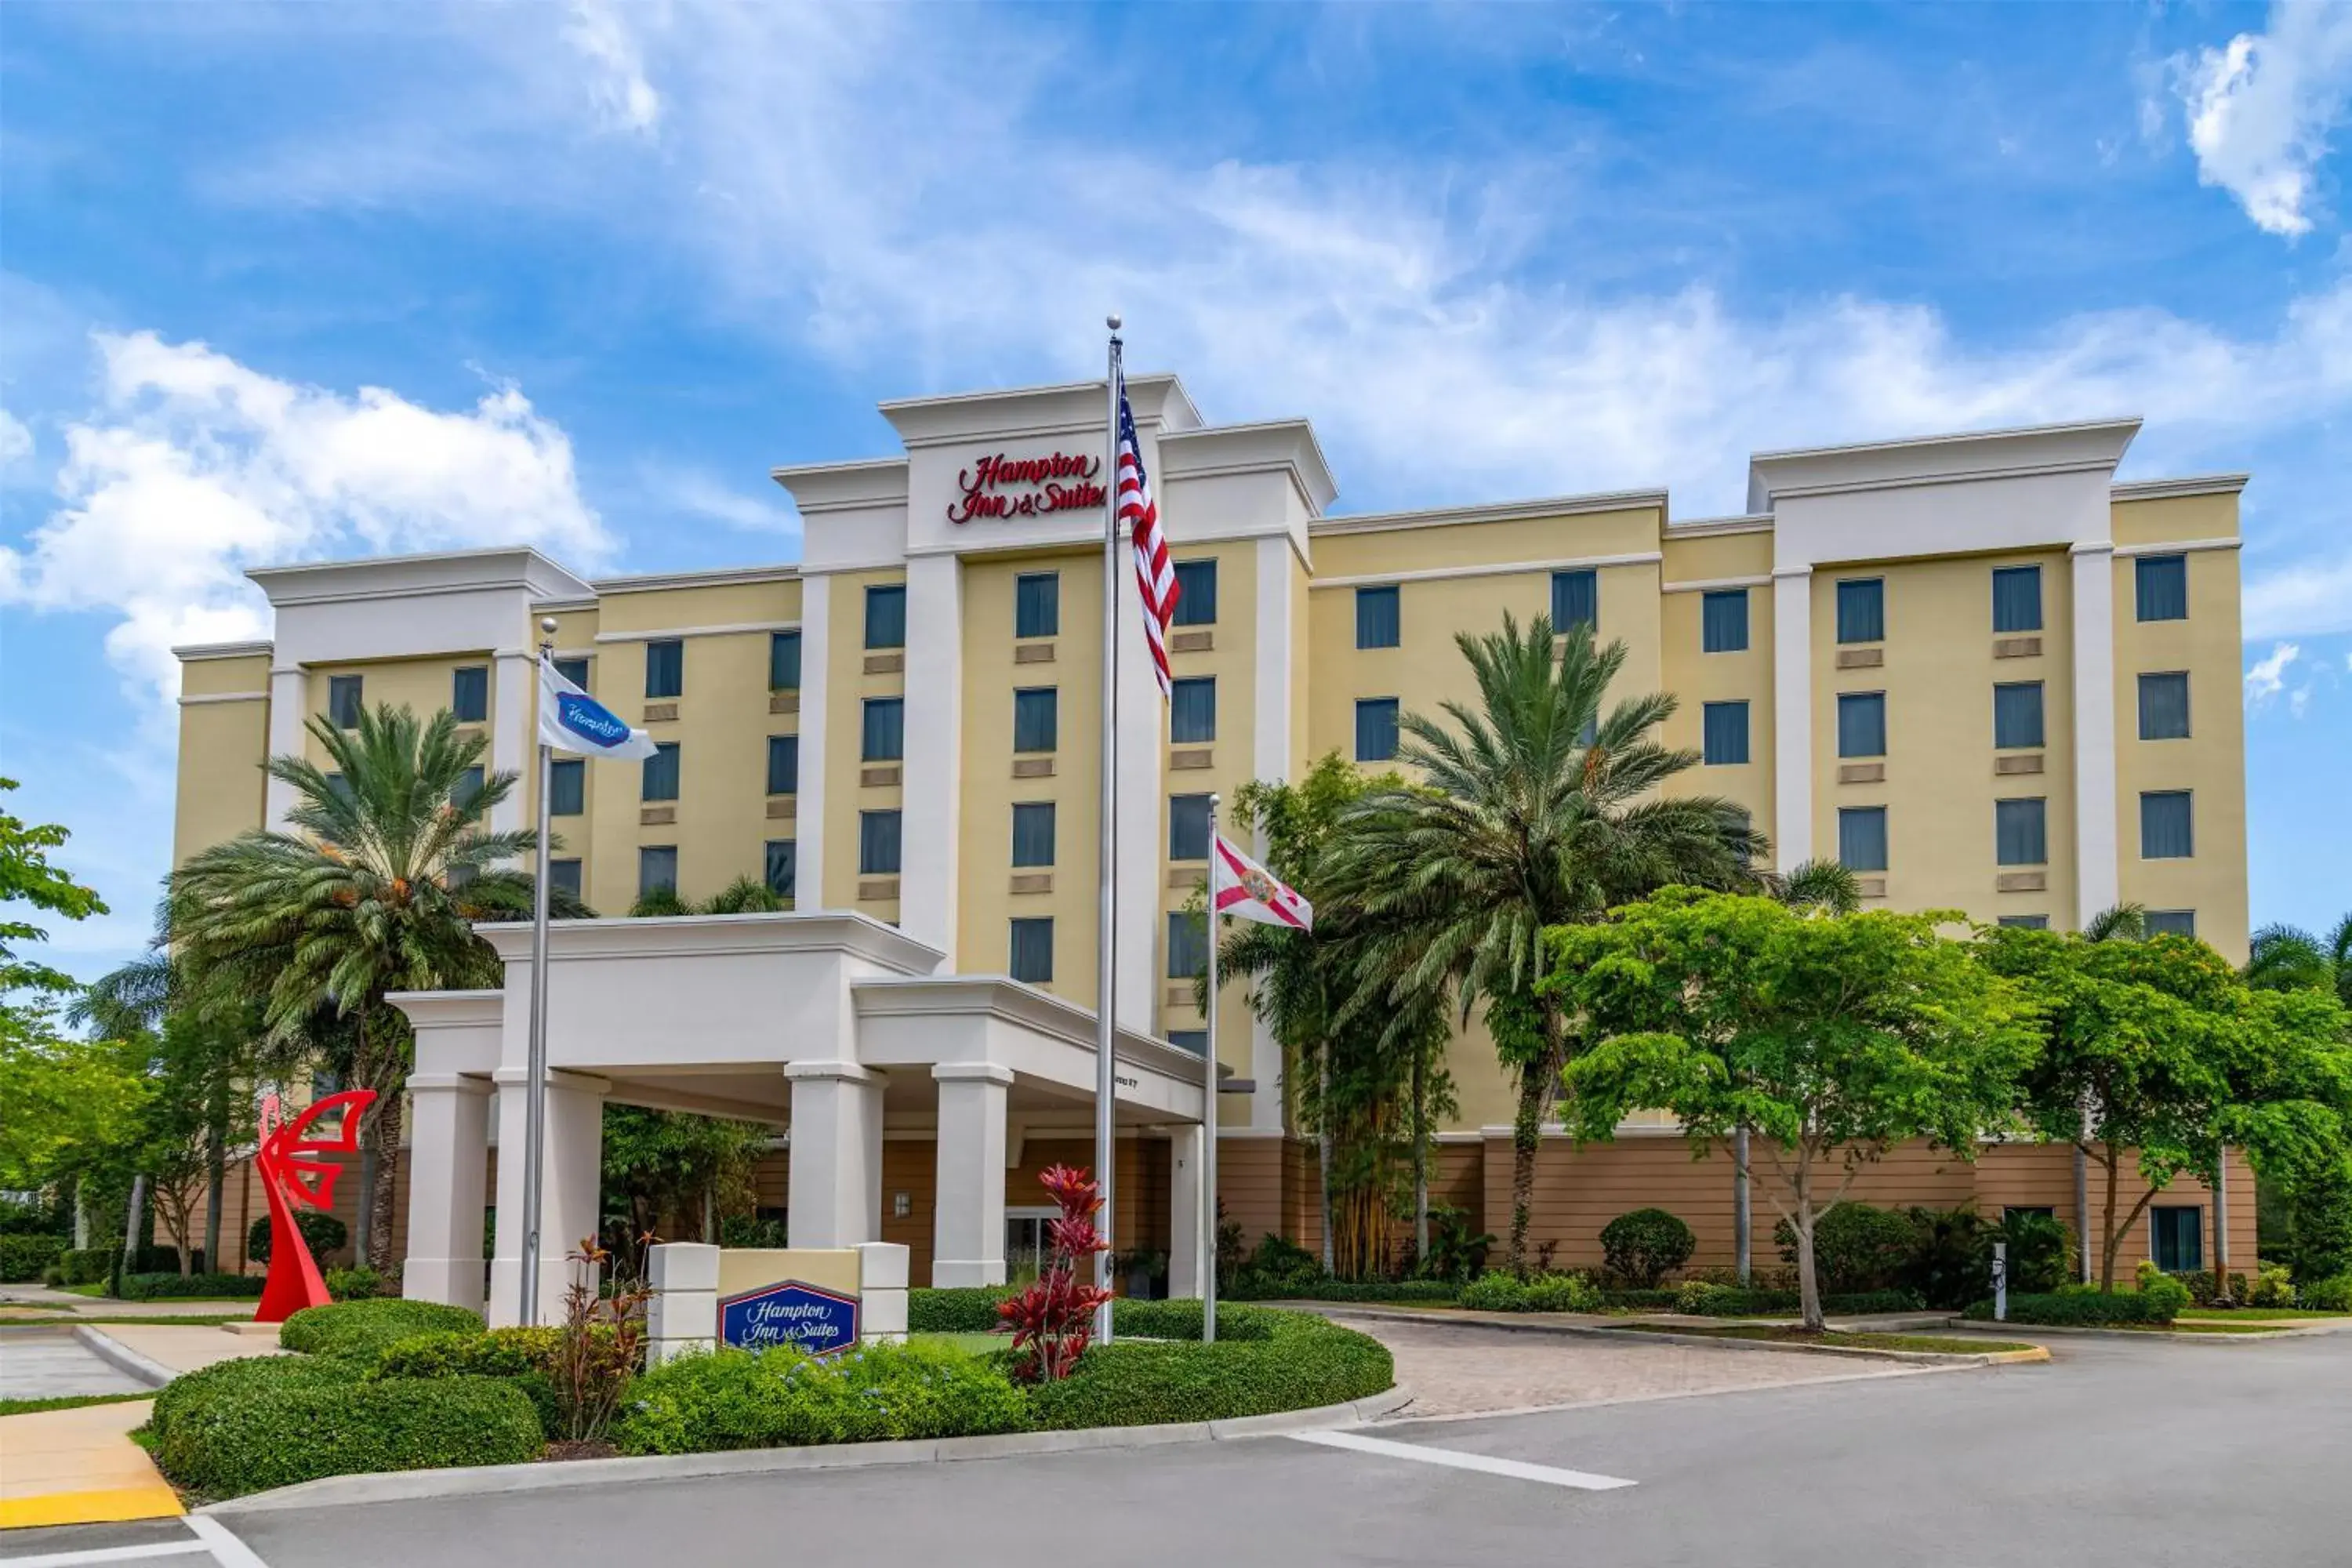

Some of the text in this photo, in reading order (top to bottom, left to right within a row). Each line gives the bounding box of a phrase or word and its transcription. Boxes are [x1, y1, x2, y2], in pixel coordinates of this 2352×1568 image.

[959, 452, 1100, 492] Hampton
[948, 491, 1018, 524] Inn
[1019, 494, 1036, 516] &
[746, 1301, 832, 1323] Hampton
[742, 1323, 785, 1341] Inn
[794, 1321, 839, 1338] Suites
